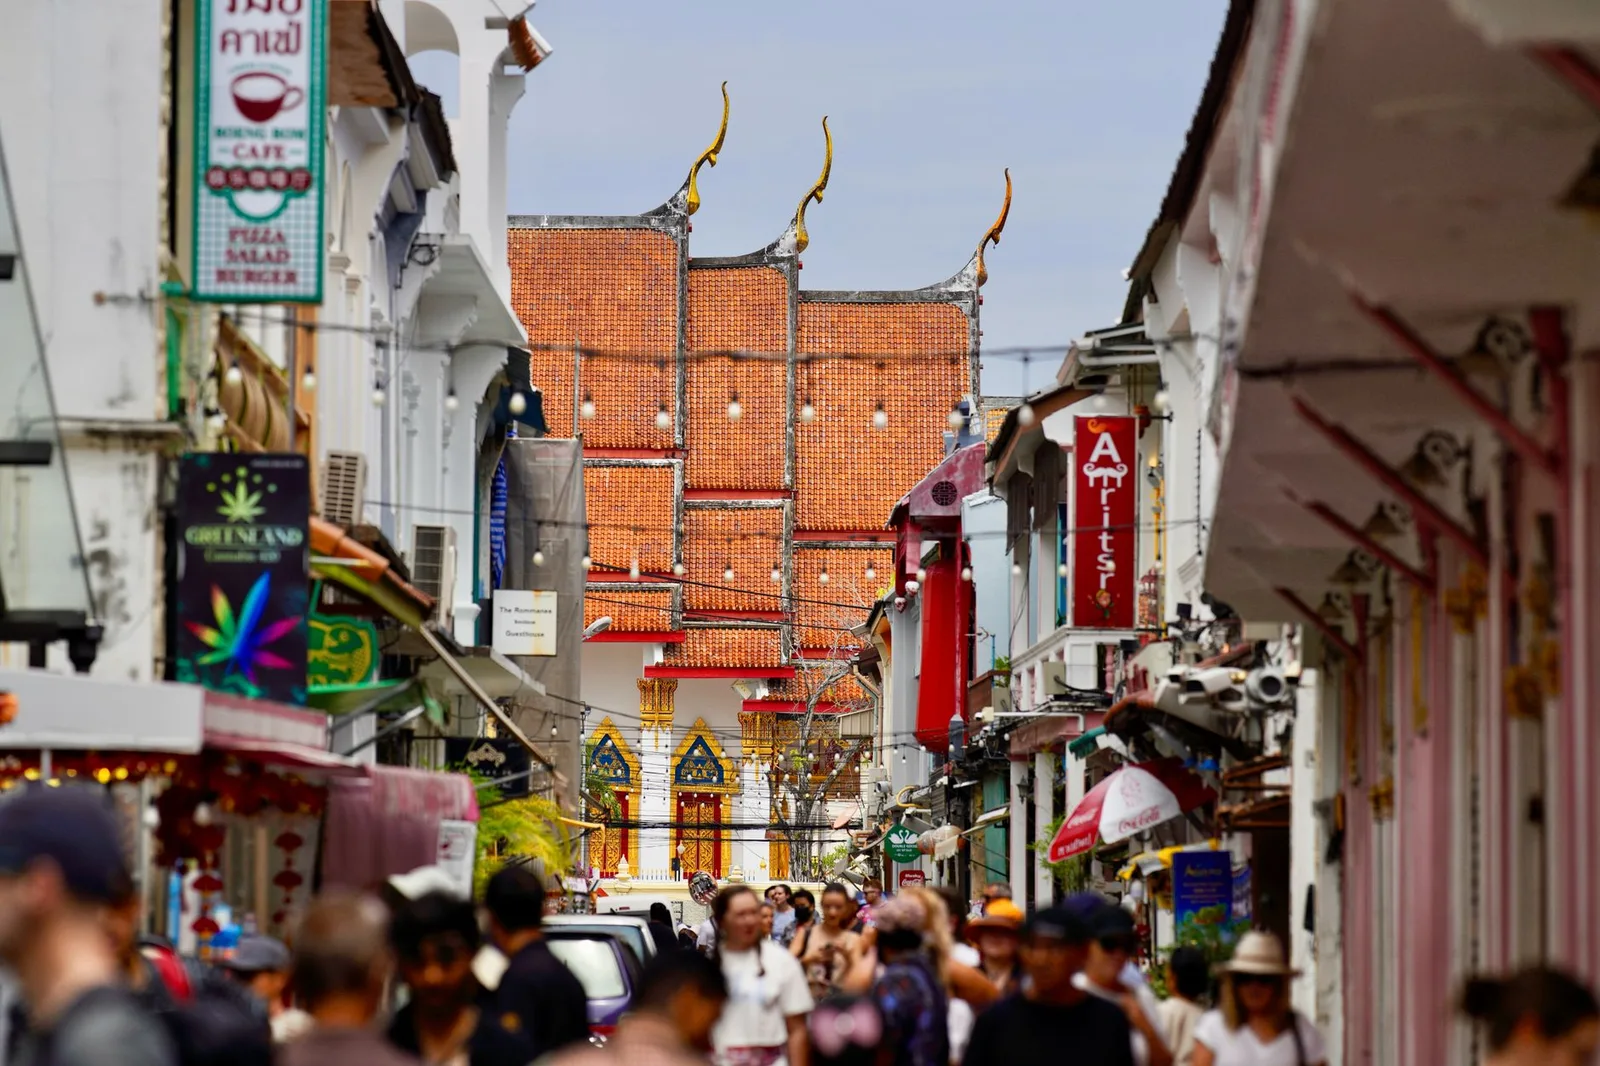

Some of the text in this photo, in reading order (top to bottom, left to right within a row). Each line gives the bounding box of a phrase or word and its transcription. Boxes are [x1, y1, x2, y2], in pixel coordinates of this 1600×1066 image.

[232, 143, 286, 160] CAFE
[228, 226, 286, 244] PIZZA
[225, 247, 291, 264] SALAD
[215, 268, 298, 284] BURGER
[184, 525, 304, 546] GREENLAND
